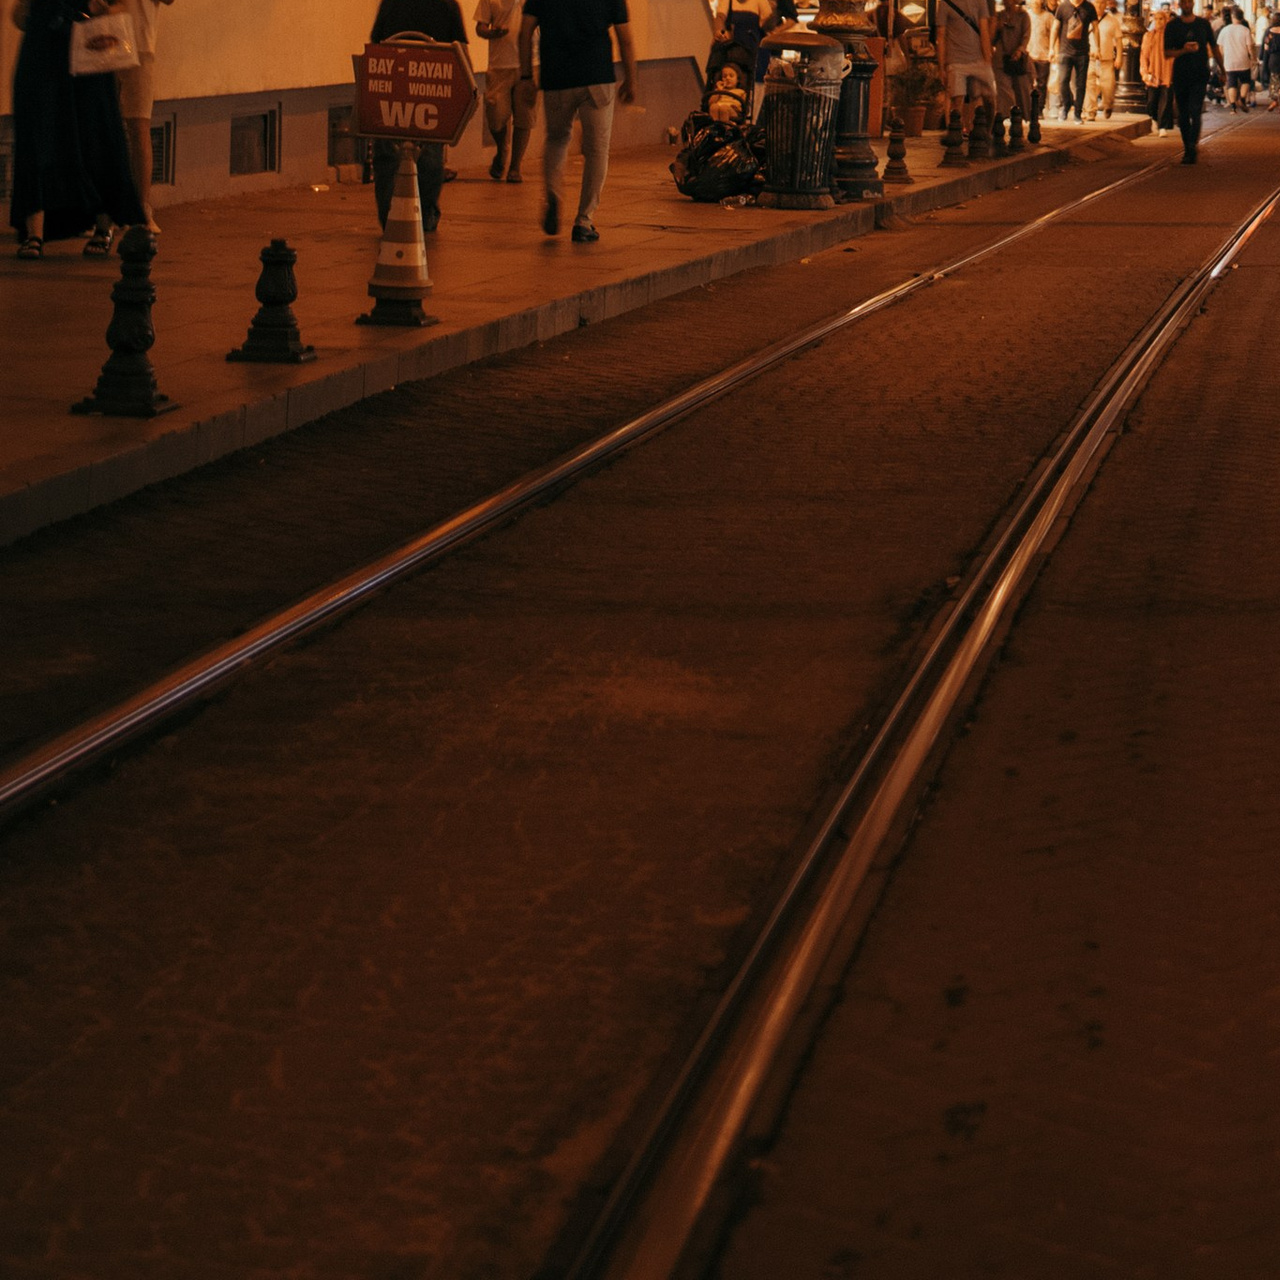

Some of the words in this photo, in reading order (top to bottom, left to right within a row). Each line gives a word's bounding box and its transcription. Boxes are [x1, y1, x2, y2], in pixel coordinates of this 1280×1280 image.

[368, 58, 395, 75] BAY
[408, 60, 453, 79] BAYAN
[368, 80, 393, 93] MEN
[409, 82, 452, 98] WOMAN
[380, 100, 438, 130] WC
